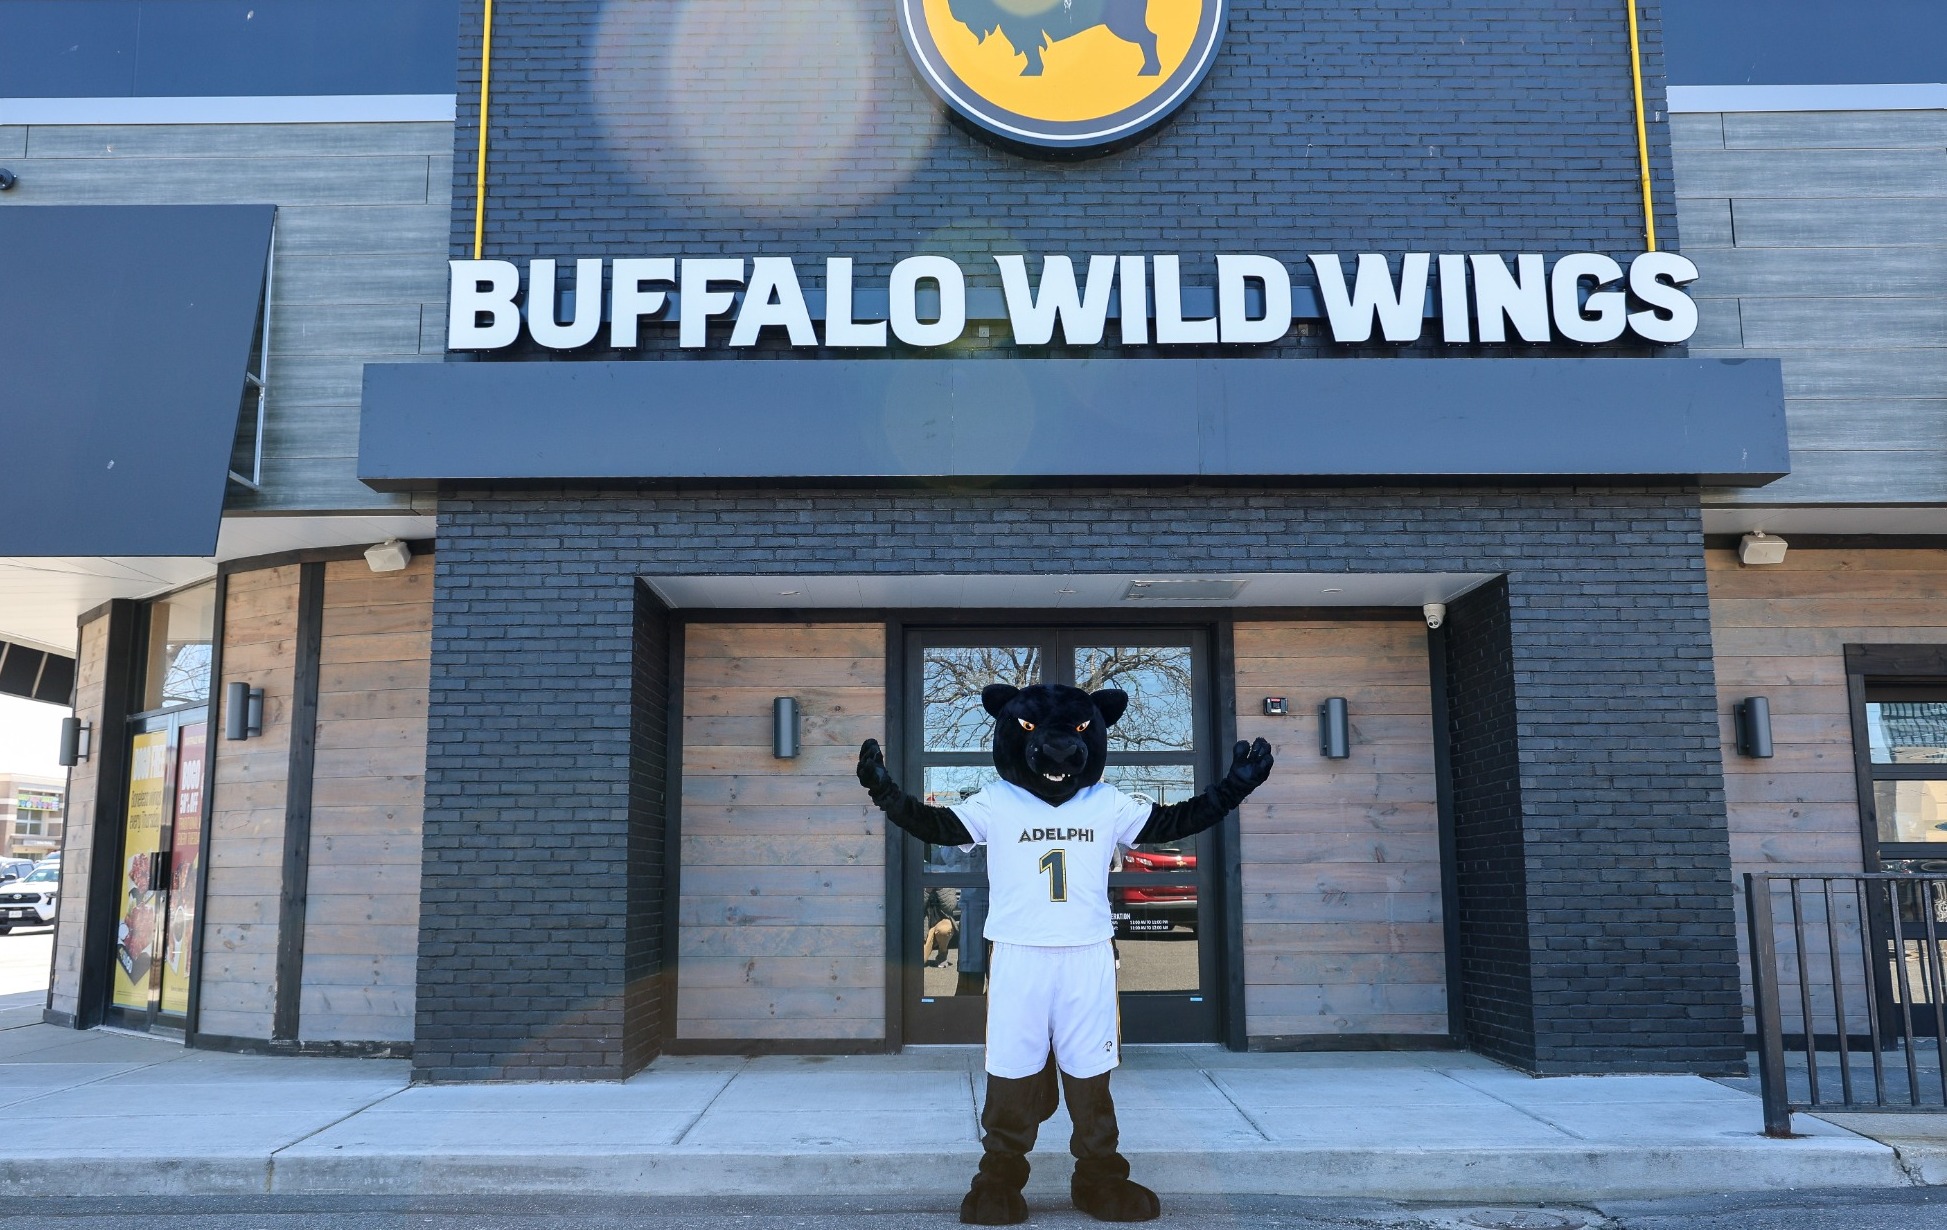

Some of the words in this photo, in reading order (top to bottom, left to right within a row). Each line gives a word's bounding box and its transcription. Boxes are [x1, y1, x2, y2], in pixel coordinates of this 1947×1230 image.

[448, 256, 967, 350] BUFFALO
[993, 253, 1292, 346] WILD
[1306, 252, 1699, 345] WINGS
[1018, 827, 1094, 843] ADELPHI
[1039, 849, 1067, 902] 1
